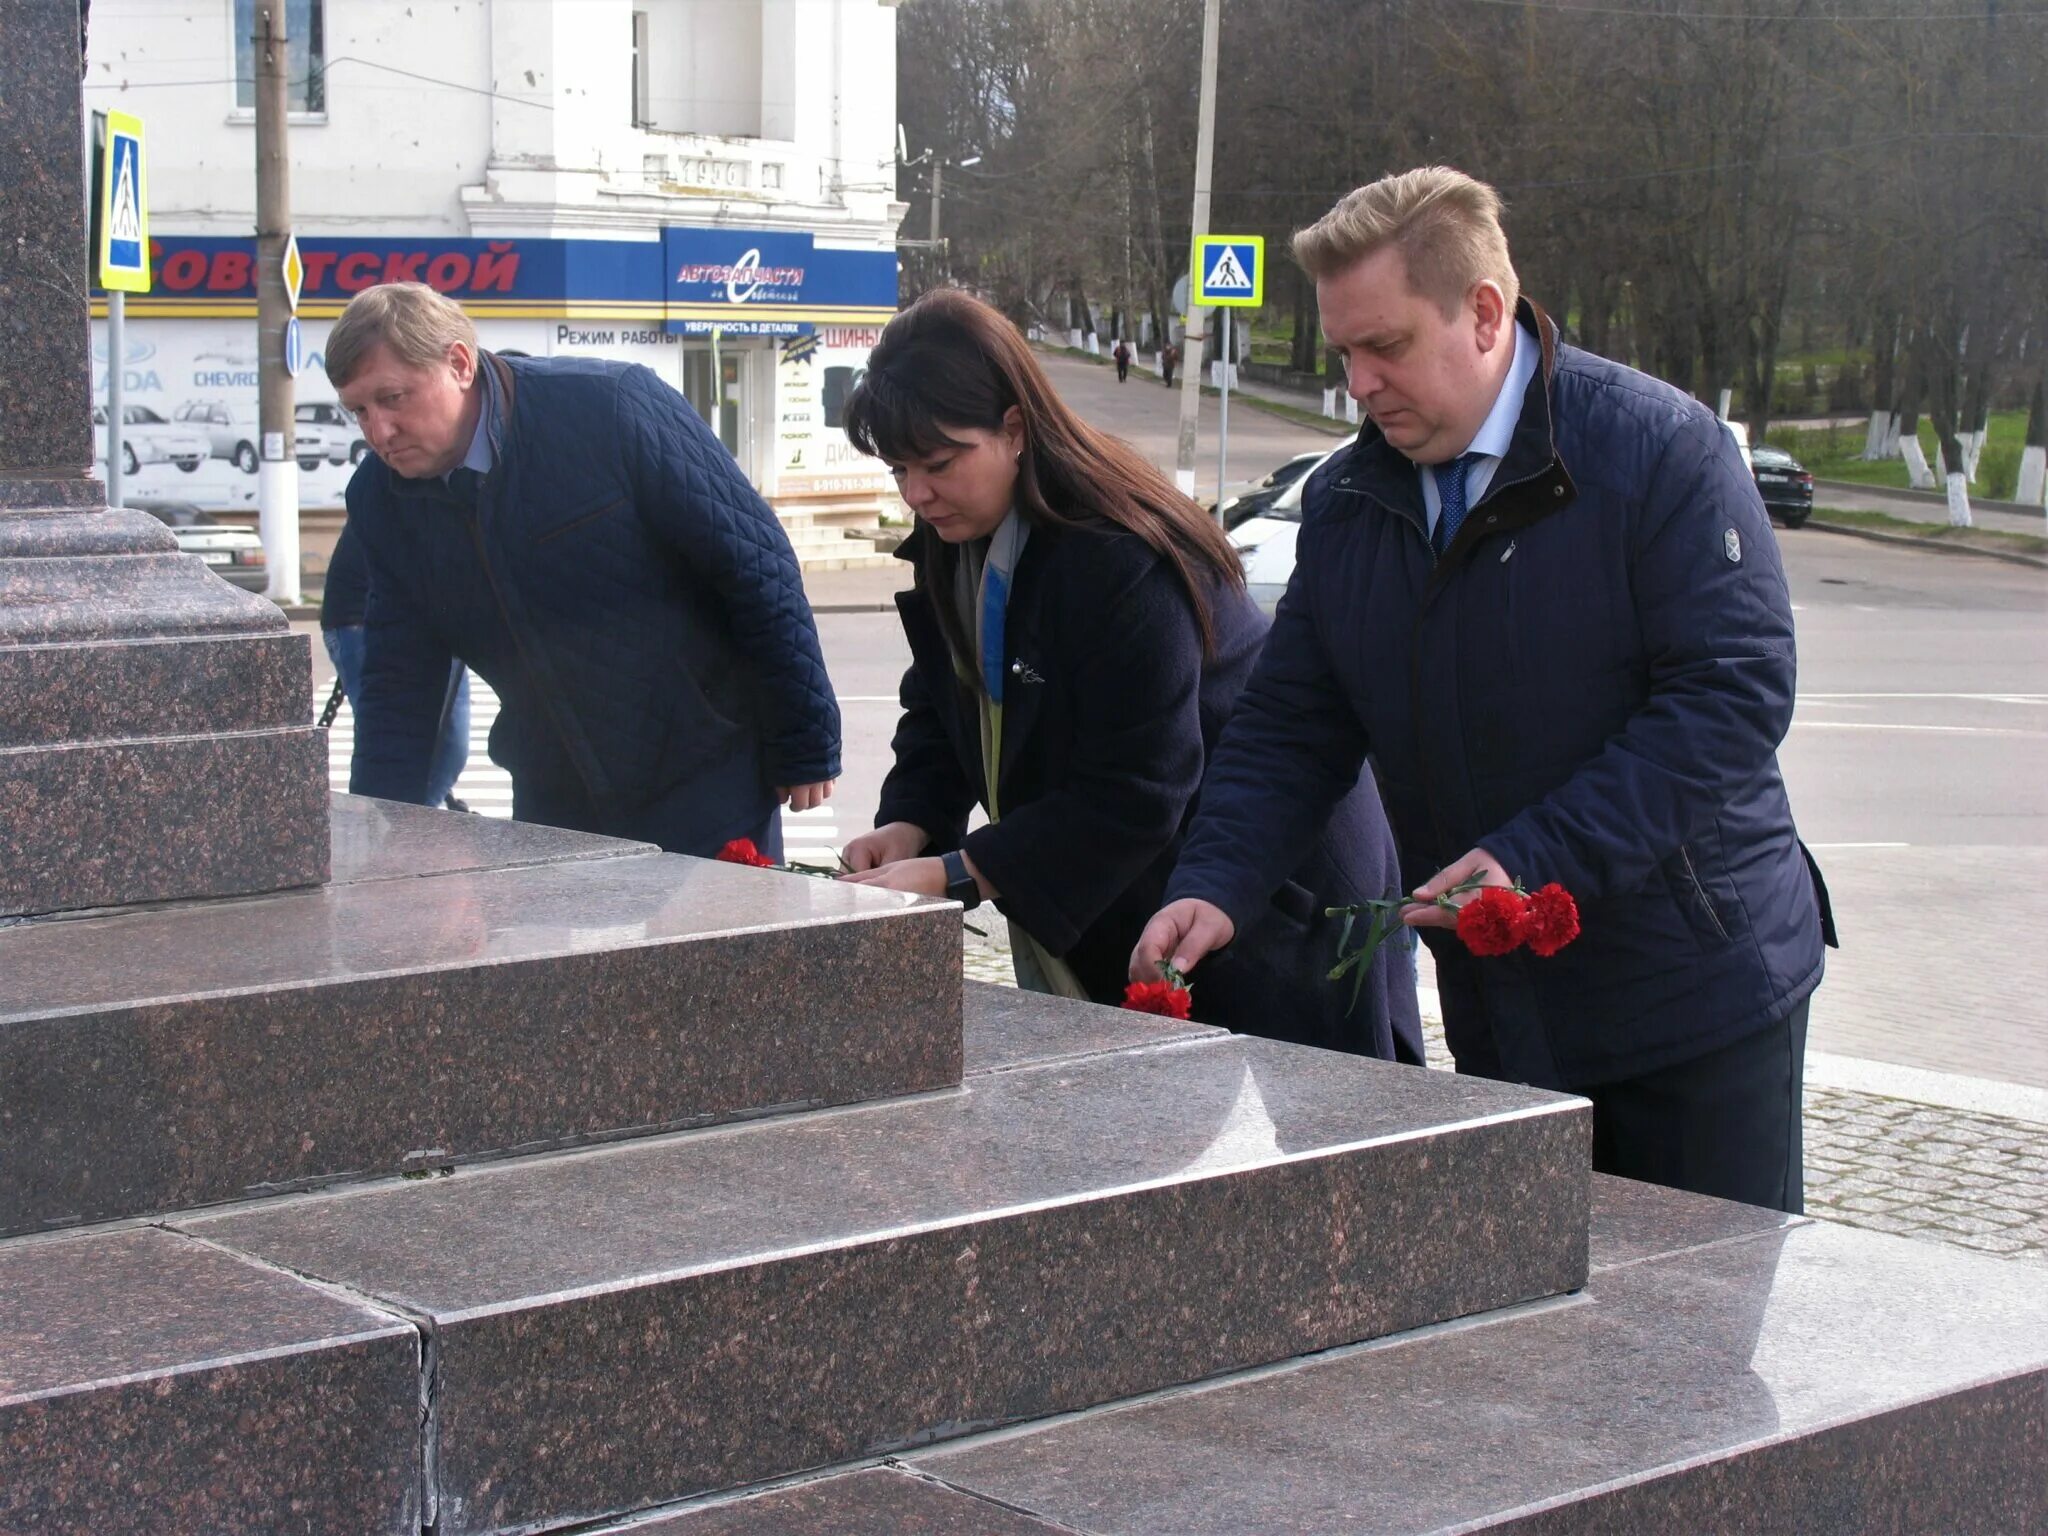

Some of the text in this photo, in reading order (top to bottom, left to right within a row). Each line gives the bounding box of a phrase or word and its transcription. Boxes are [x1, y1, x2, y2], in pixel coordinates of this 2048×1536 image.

[149, 241, 519, 291] овтской
[677, 264, 804, 286] АВТОЗАПЧАСТИ
[759, 323, 799, 334] ДЕТАЛЯХ
[194, 371, 259, 387] CHEVRO
